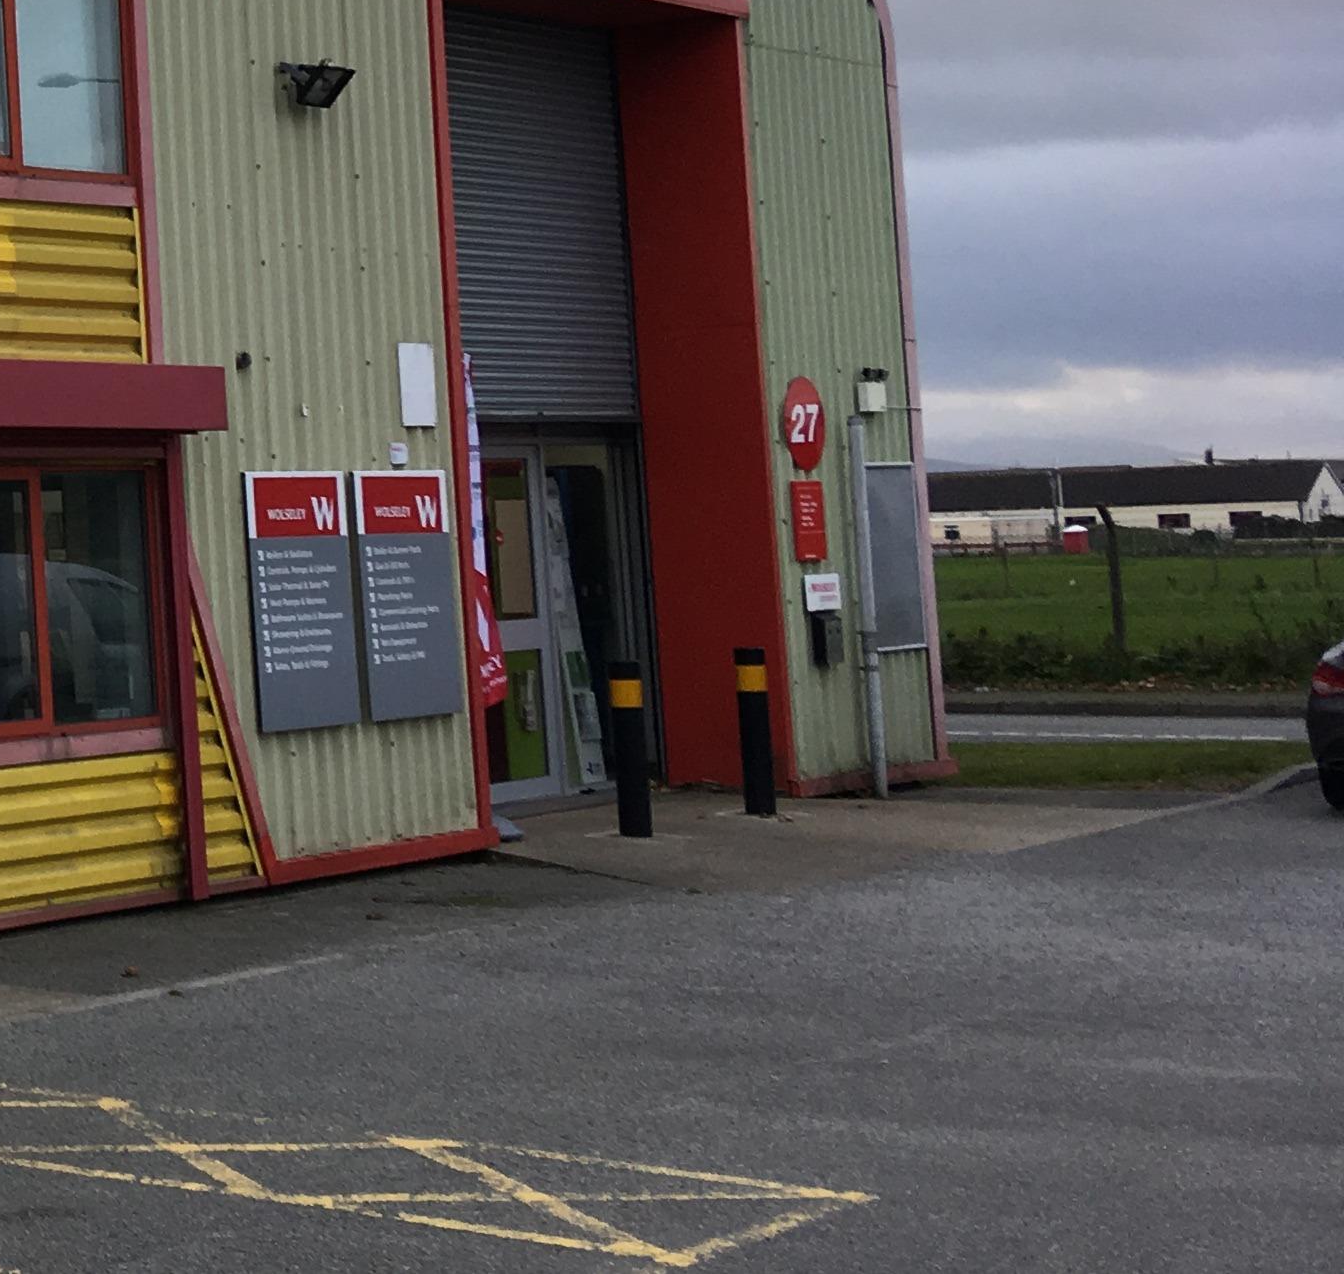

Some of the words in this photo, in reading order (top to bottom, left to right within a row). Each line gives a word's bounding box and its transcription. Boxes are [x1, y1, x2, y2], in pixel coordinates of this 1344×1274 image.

[790, 404, 819, 443] 27
[310, 496, 334, 531] W
[414, 495, 437, 528] W
